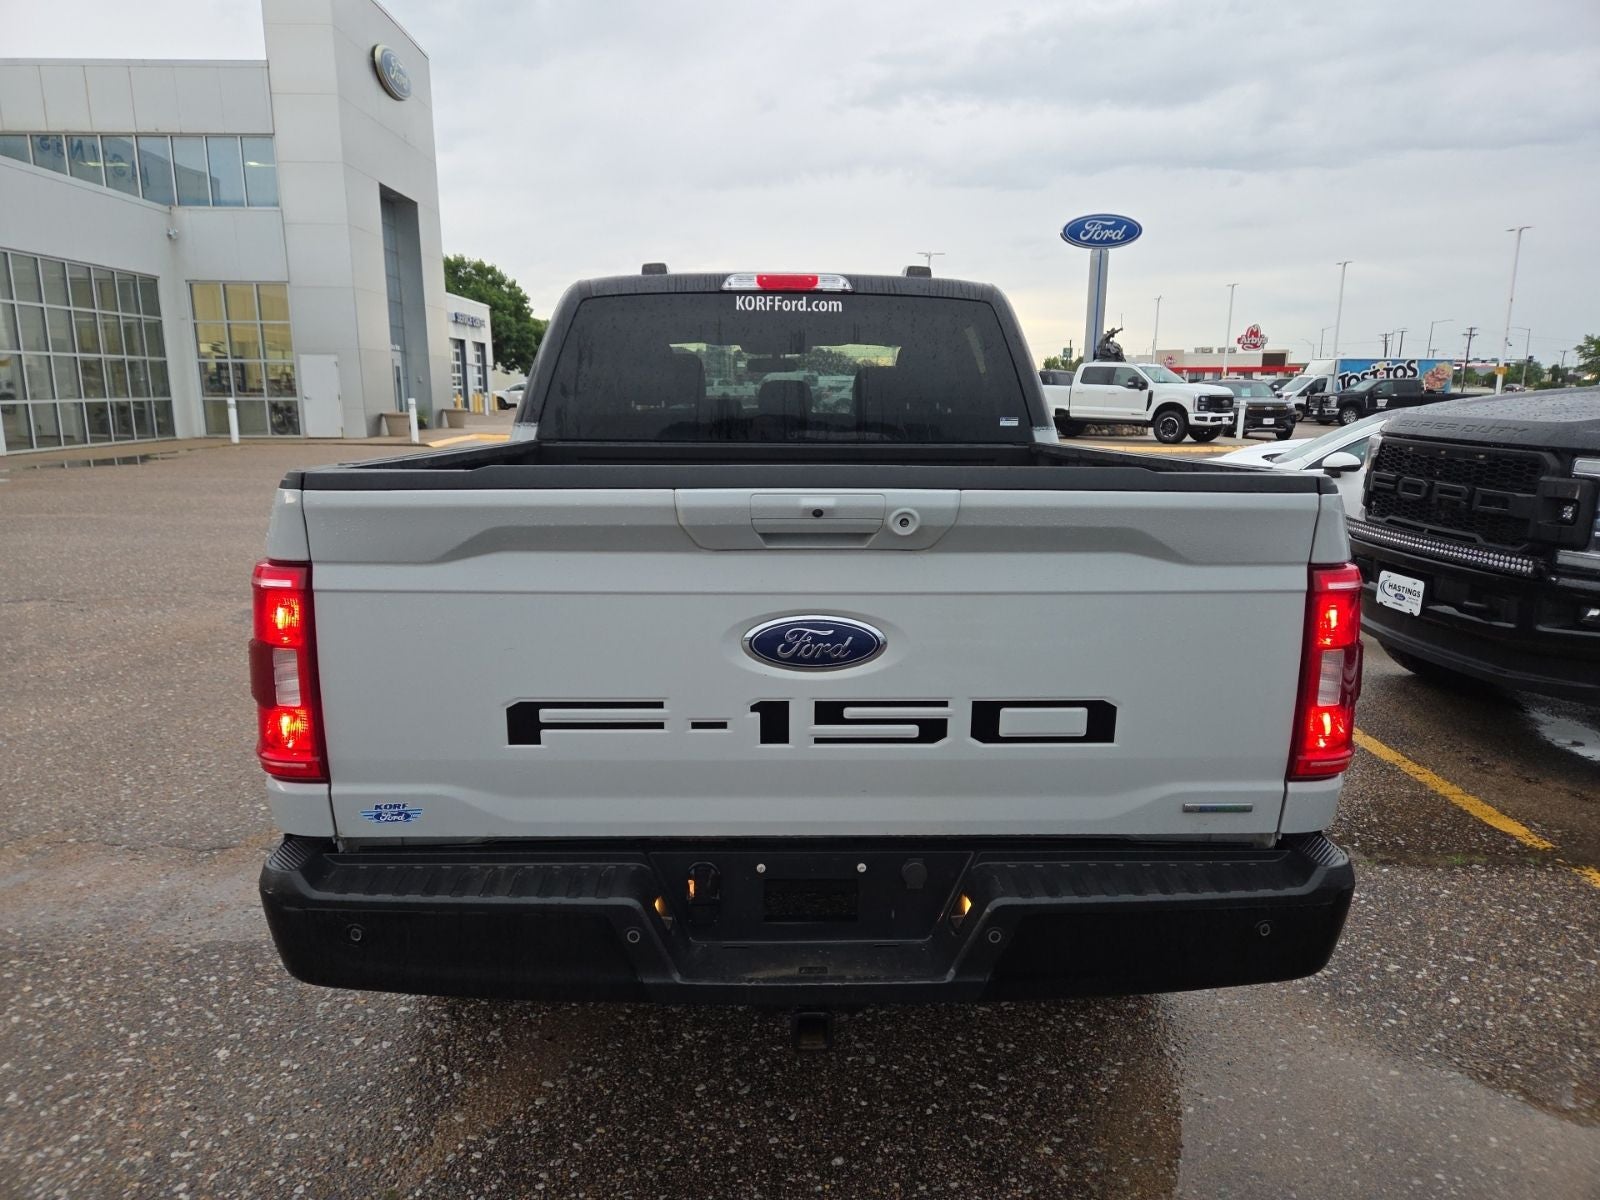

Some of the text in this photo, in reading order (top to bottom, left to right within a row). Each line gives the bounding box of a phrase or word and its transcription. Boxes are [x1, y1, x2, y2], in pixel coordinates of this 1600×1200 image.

[1080, 220, 1127, 240] Ford
[735, 295, 843, 312] KORFFord.com
[1398, 419, 1529, 436] SUPER DUTY
[1368, 470, 1517, 512] FORD
[1388, 582, 1421, 598] HASTINGS
[777, 627, 853, 659] Ford
[506, 700, 1118, 745] F-150
[374, 803, 408, 811] KORF
[380, 810, 405, 821] Ford
